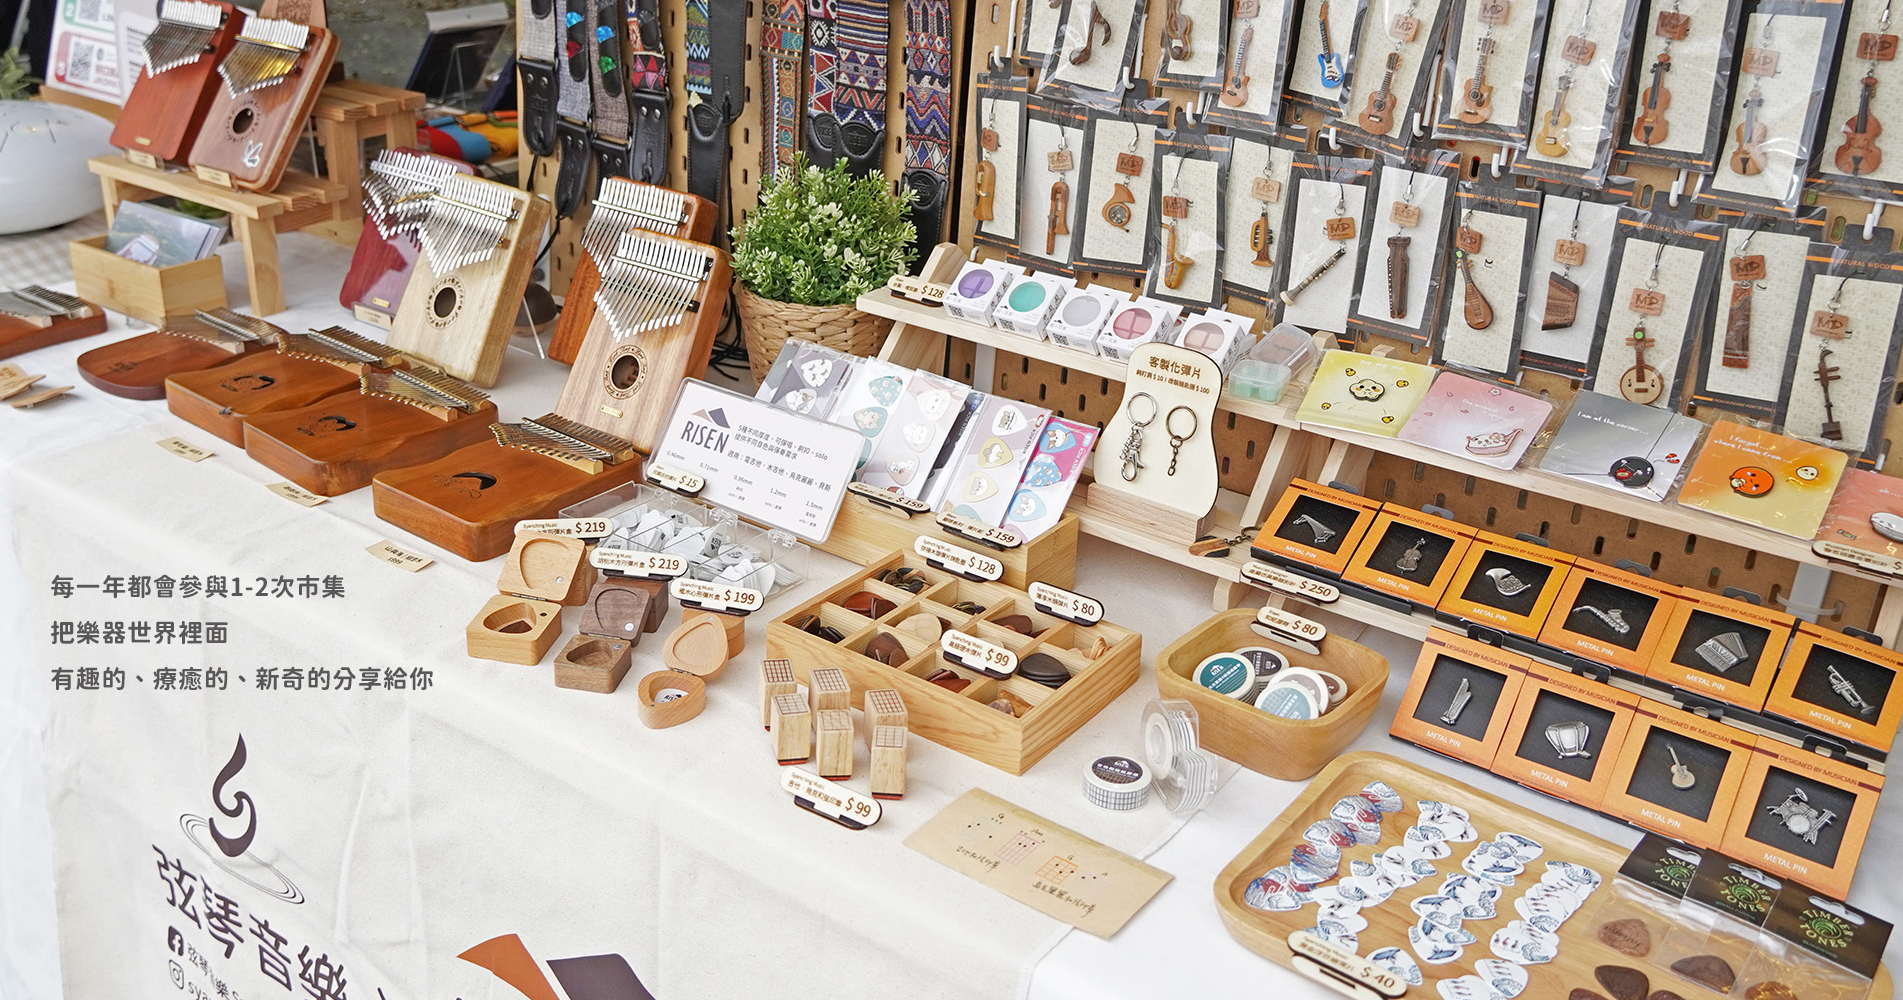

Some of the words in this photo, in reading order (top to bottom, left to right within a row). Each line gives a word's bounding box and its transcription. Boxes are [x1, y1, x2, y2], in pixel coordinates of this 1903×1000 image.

[1475, 193, 1498, 203] NATURAL
[1499, 197, 1517, 205] WOOD
[1644, 223, 1671, 233] NATURAL
[1672, 228, 1694, 237] WOOD
[1868, 261, 1890, 269] WOOD
[921, 285, 928, 295] $
[928, 287, 945, 299] 128
[1148, 356, 1201, 380] 客製化彈片
[1200, 387, 1210, 395] 100
[680, 420, 730, 454] RISEN
[1714, 439, 1736, 449] where
[699, 462, 719, 473] 0.71mm
[679, 475, 687, 485] $
[686, 478, 698, 488] 15
[733, 474, 753, 486] 0.96mm
[769, 488, 787, 498] 1.2mm
[805, 500, 823, 511] 1.5mm
[905, 500, 924, 508] 159
[575, 522, 582, 534] $
[585, 522, 606, 533] 219
[985, 528, 995, 537] $
[994, 532, 1015, 543] 159
[1286, 545, 1306, 556] METAL
[649, 556, 656, 569] $
[659, 558, 680, 571] 219
[968, 555, 977, 569] $
[976, 560, 996, 575] 128
[1299, 580, 1308, 590] $
[1308, 583, 1332, 597] 250
[1377, 576, 1398, 587] METAL
[1397, 583, 1410, 591] PIN
[723, 590, 732, 603] $
[733, 592, 755, 605] 199
[1072, 599, 1080, 612] $
[1081, 602, 1095, 616] 80
[1473, 607, 1495, 618] METAL
[1495, 614, 1507, 622] PIN
[1292, 620, 1301, 630] $
[1301, 623, 1318, 636] 80
[1446, 643, 1470, 656] DESIGNED
[1481, 653, 1509, 668] MUSICIAN
[1577, 639, 1601, 651] METAL
[1601, 648, 1614, 657] PIN
[985, 648, 994, 662] $
[994, 652, 1010, 667] 99
[1686, 673, 1710, 686] METAL
[1710, 682, 1725, 691] PIN
[1549, 678, 1576, 692] DESIGNED
[1586, 689, 1616, 705] MUSICIAN
[1809, 709, 1836, 724] METAL
[1836, 719, 1852, 730] PIN
[1658, 715, 1688, 731] DESIGNED
[1698, 727, 1730, 743] MUSICIAN
[1426, 730, 1448, 743] METAL
[1449, 739, 1462, 748] PIN
[1530, 769, 1554, 783] METAL
[1555, 778, 1568, 788] PIN
[1779, 755, 1811, 771] DESIGNED
[1813, 766, 1822, 774] BY
[1823, 769, 1858, 786] MUSICIAN
[845, 796, 855, 811] $
[855, 801, 871, 818] 99
[1640, 808, 1666, 824] METAL
[1667, 818, 1681, 828] PIN
[1763, 853, 1791, 869] METAL
[1792, 863, 1808, 875] PIN
[1723, 874, 1771, 902] TIMBER
[1720, 888, 1766, 913] TONES
[1803, 908, 1854, 937] TIMBER
[1799, 923, 1847, 948] TONES
[1360, 965, 1371, 978] $
[1374, 973, 1395, 988] 40
